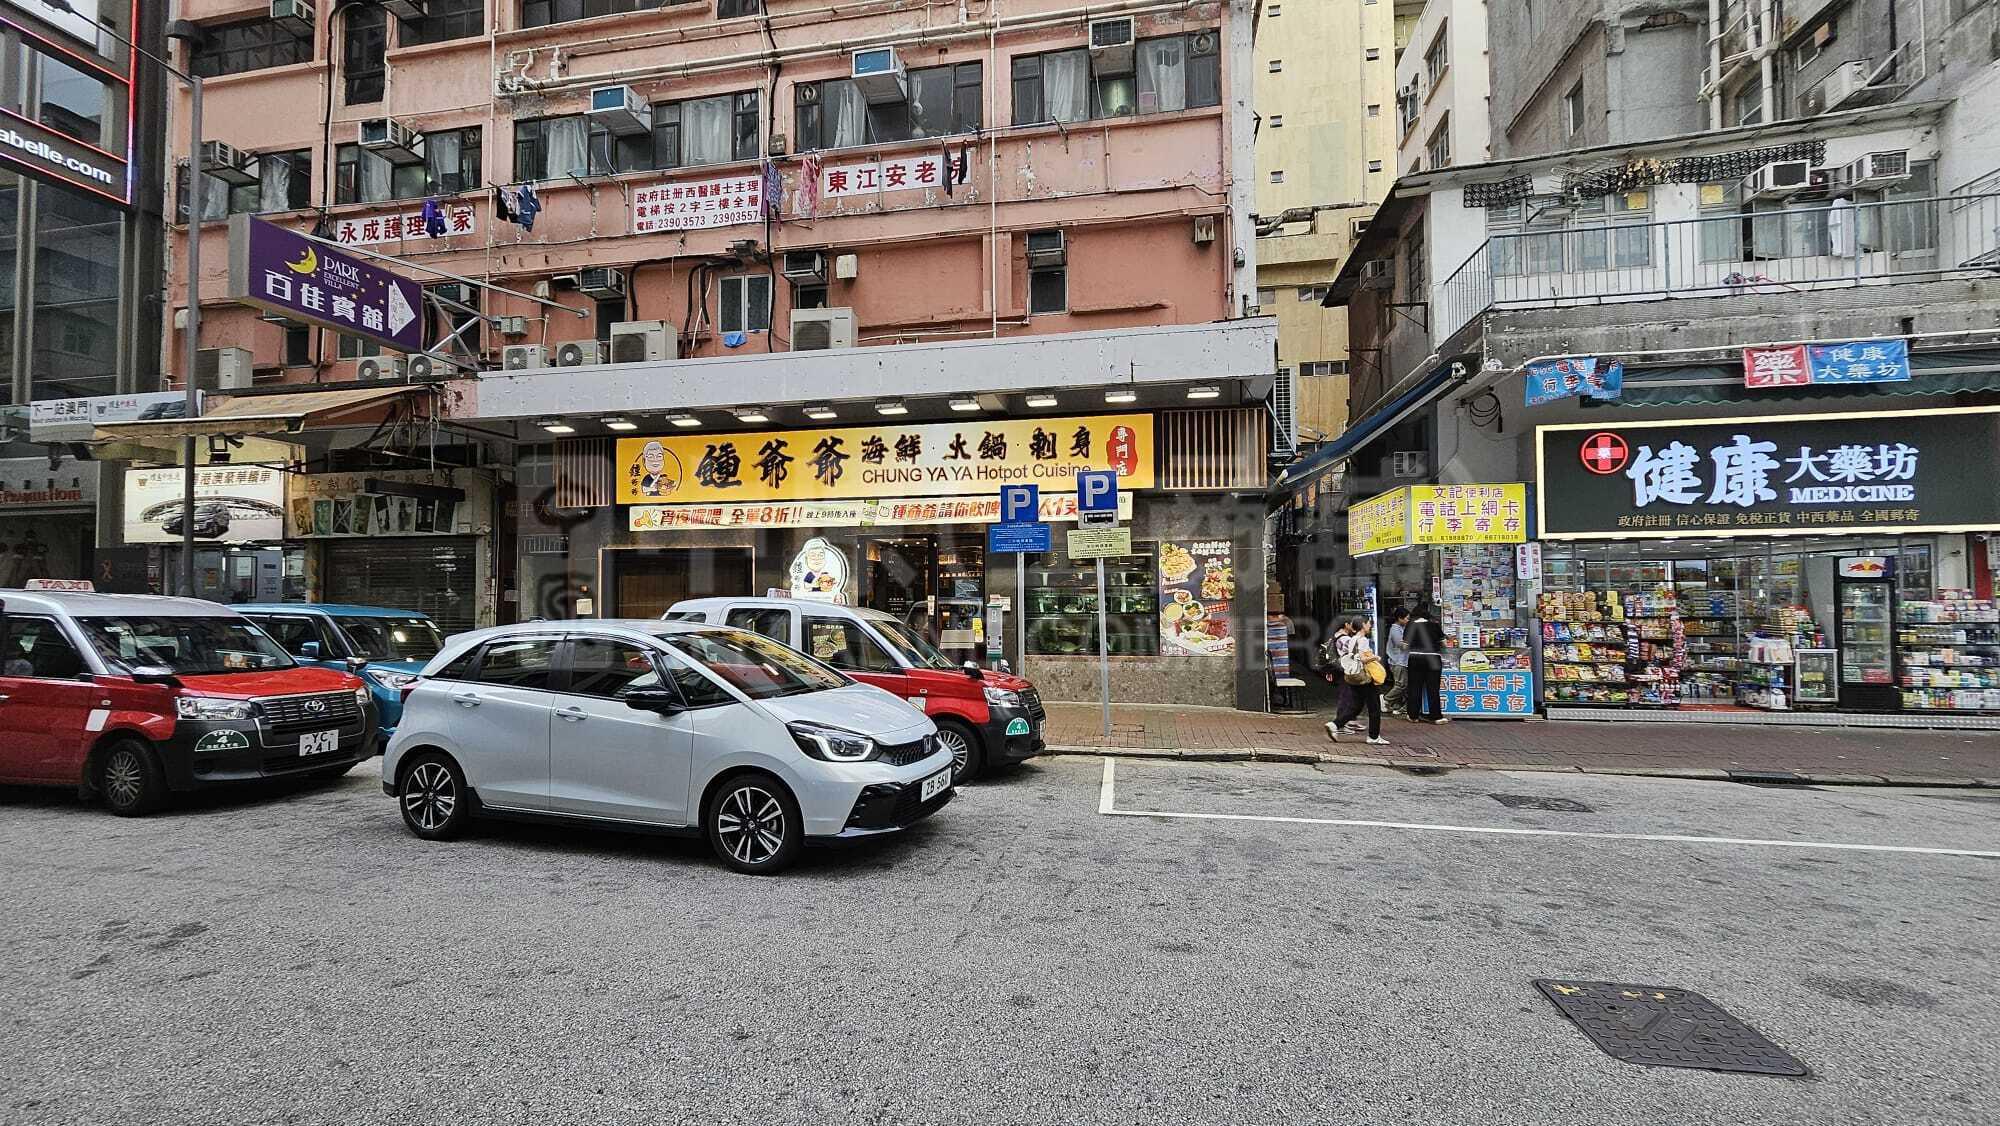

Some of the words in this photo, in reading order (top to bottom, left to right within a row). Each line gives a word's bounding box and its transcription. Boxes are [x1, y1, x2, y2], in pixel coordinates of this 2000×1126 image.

[340, 210, 472, 243] 永成護理家
[658, 216, 706, 229] 23903573
[713, 211, 758, 224] 23903557
[323, 256, 360, 282] PARK
[323, 271, 359, 289] EXCELLENT
[323, 278, 342, 290] VILLA
[1830, 346, 1887, 362] 健康
[1817, 362, 1901, 379] 大藥坊
[861, 434, 922, 464] 海鮮
[943, 431, 1007, 461] 火鍋
[862, 467, 922, 484] CHUNG
[924, 466, 948, 482] YA
[950, 465, 973, 481] YA
[977, 464, 1028, 482] Hotpot
[1626, 434, 1781, 508] 健康
[1784, 443, 1920, 483] 大藥坊
[1086, 475, 1109, 507] P
[1433, 487, 1503, 499] 文記便利店
[1790, 485, 1914, 504] MEDICINE
[1008, 489, 1030, 519] P
[1419, 500, 1519, 517] 電話上網卡
[1419, 518, 1520, 533] 行李寄存
[1676, 513, 1731, 526] 信心保證
[1796, 510, 1854, 523] 中西藥品
[1859, 509, 1920, 522] 全國郵寄
[39, 580, 90, 590] TAXI
[217, 735, 228, 743] 4
[312, 732, 329, 743] YC
[304, 741, 331, 755] 241
